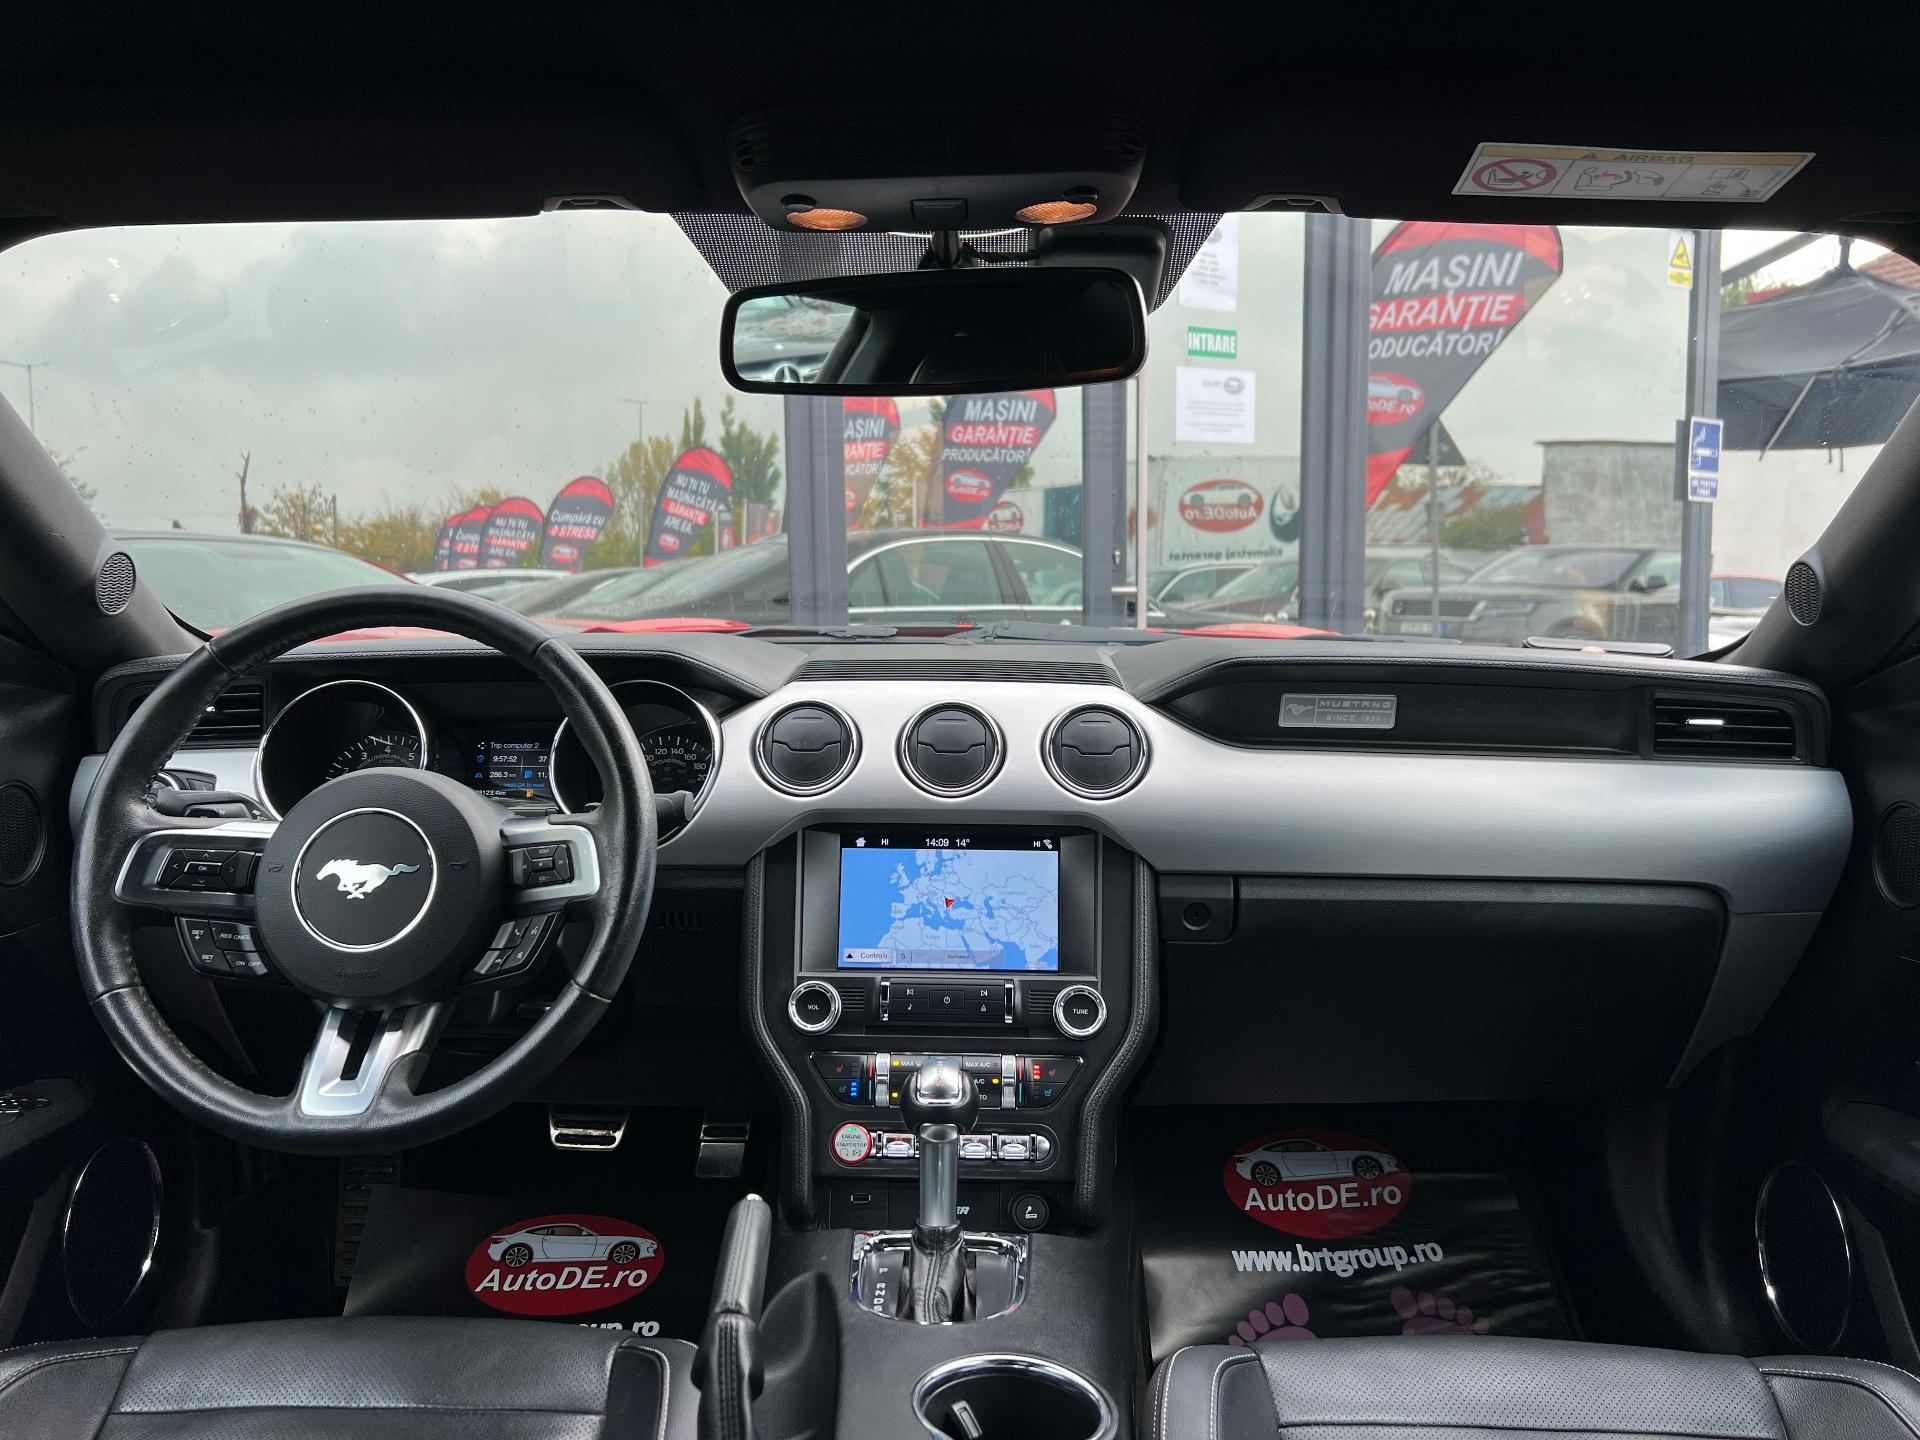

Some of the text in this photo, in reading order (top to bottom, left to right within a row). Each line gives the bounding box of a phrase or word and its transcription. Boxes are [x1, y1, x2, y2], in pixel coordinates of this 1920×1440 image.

[1614, 153, 1695, 163] AIRBAG
[1188, 332, 1236, 354] INTRARE
[1320, 700, 1393, 708] MUSTANG
[384, 745, 391, 753] 4
[503, 742, 534, 750] computer
[671, 747, 684, 755] 140
[361, 752, 368, 760] 3
[408, 752, 415, 761] 5
[492, 755, 518, 763] 9:57:52
[538, 755, 548, 763] 37
[684, 753, 697, 761] 160
[693, 762, 706, 770] 180
[881, 838, 889, 846] HI
[925, 838, 970, 847] 14:09 14°
[1033, 840, 1041, 848] HI
[860, 951, 888, 960] Controls
[807, 1003, 820, 1011] VOL
[1244, 1183, 1402, 1212] AutoDE.ro
[1231, 1242, 1444, 1278] www.brtgroup.ro
[473, 1265, 648, 1292] AutoDE.ro
